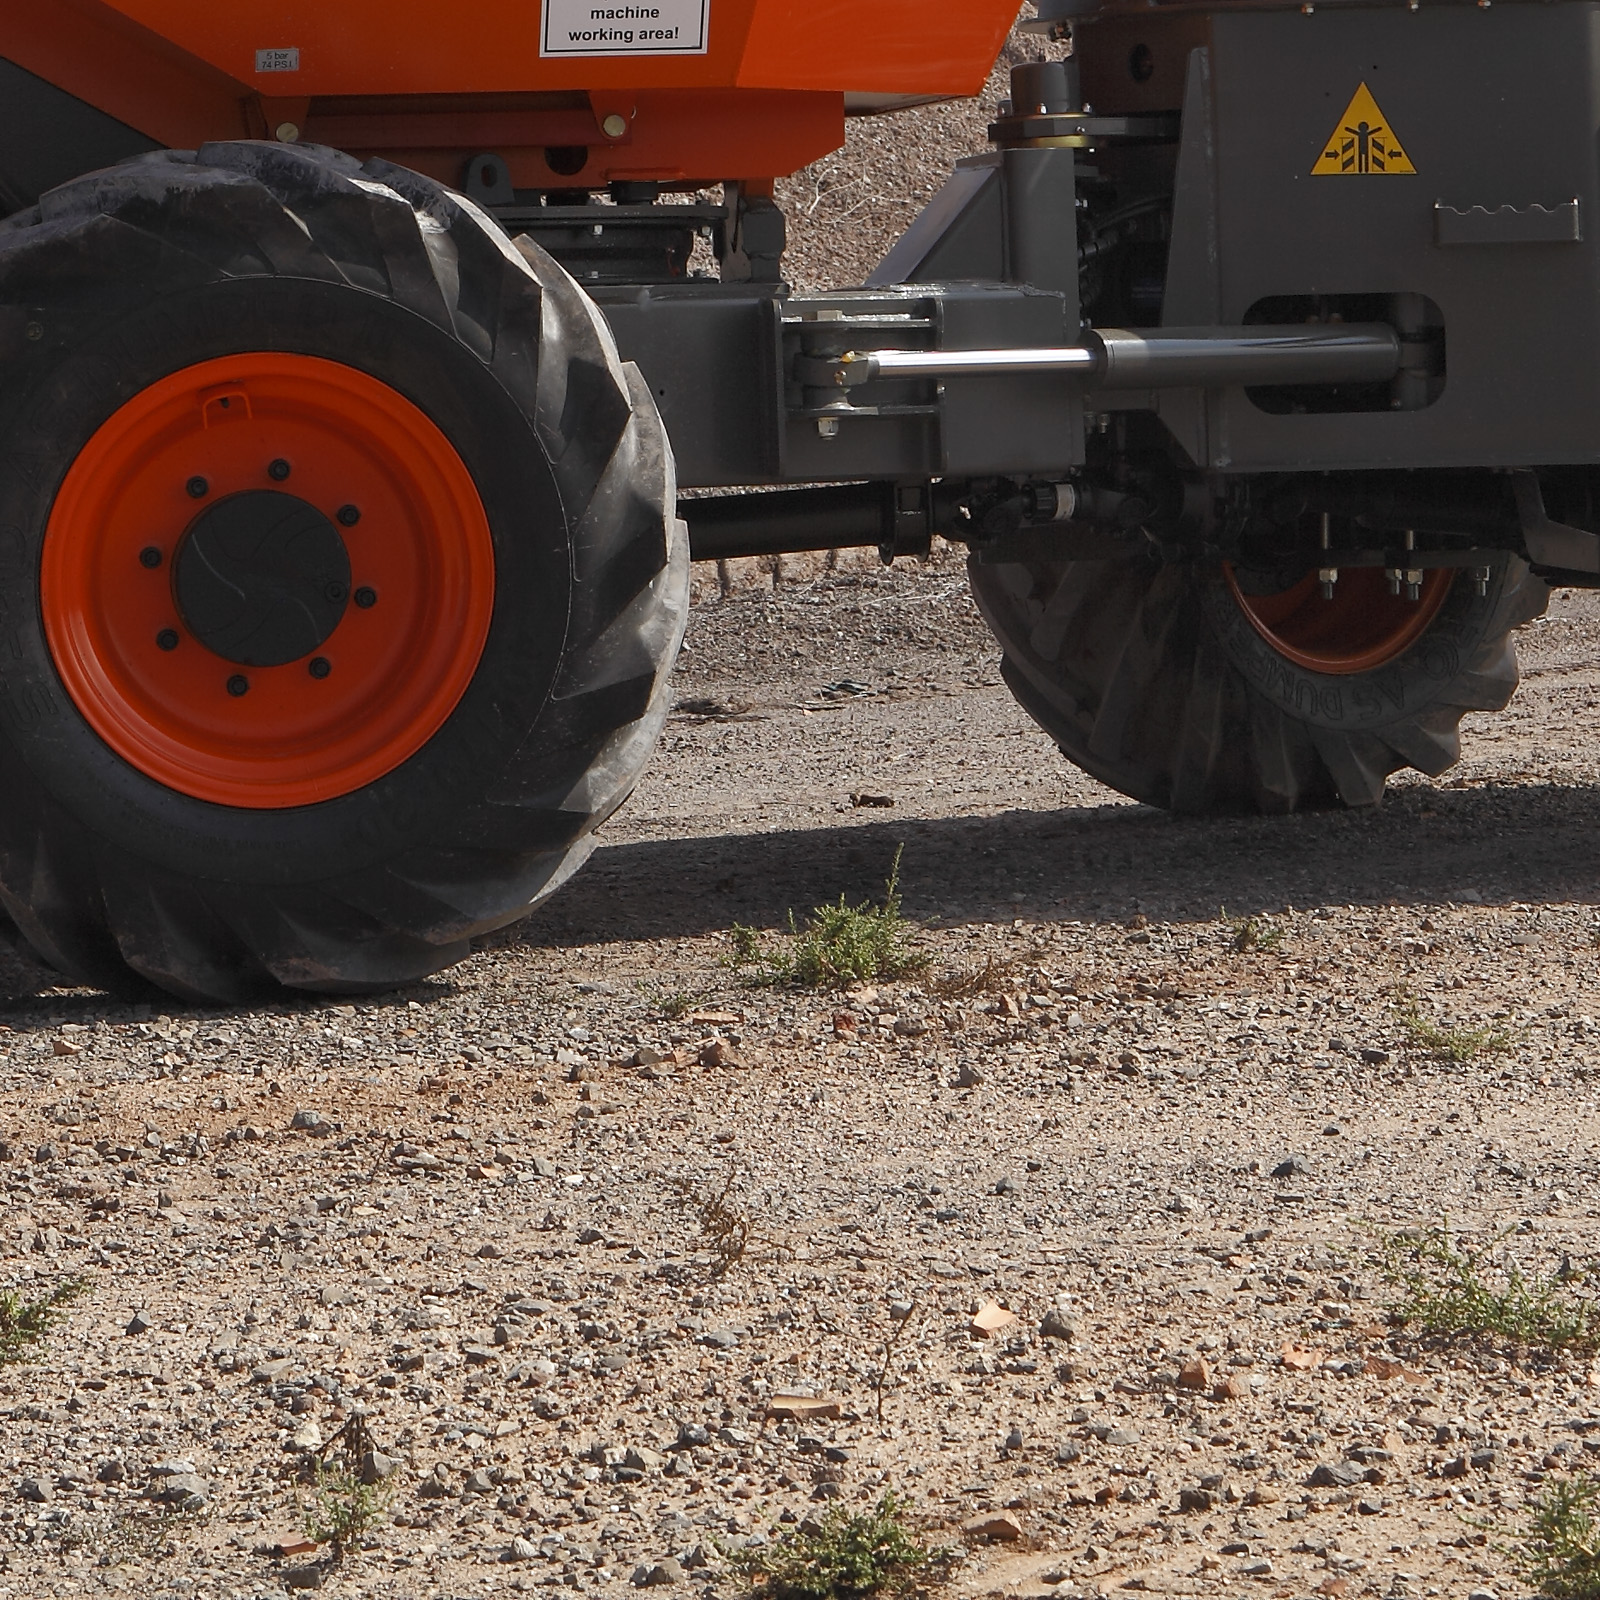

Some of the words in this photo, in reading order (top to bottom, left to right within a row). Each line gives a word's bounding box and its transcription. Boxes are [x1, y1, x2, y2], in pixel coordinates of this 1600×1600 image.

[590, 6, 660, 20] machine
[568, 28, 634, 43] working
[638, 27, 679, 41] area!
[266, 52, 273, 60] 5
[274, 51, 289, 60] bar
[262, 60, 272, 69] 74
